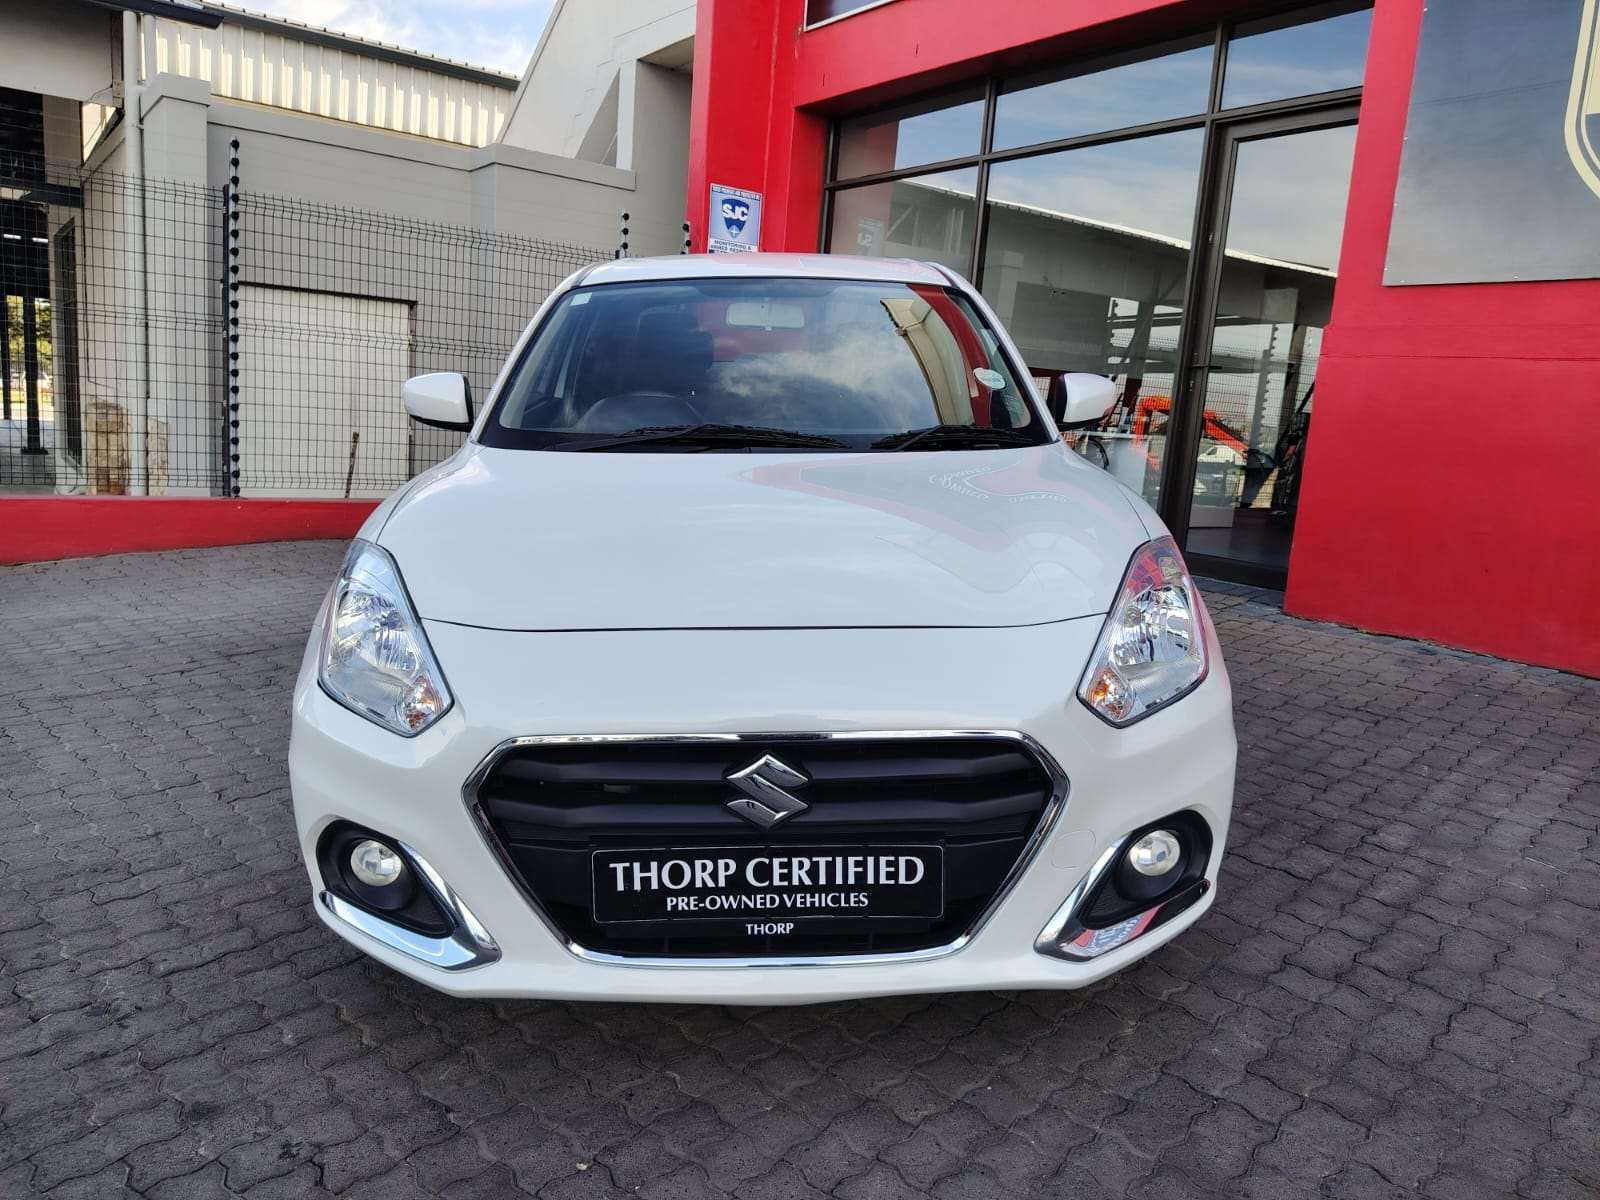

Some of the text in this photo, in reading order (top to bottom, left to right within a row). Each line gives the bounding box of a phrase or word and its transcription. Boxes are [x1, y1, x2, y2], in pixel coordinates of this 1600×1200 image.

[722, 203, 748, 221] SJC
[609, 856, 925, 892] THORP CERTIFIED
[666, 892, 869, 911] PRE-OWNED VEHICLES
[745, 922, 794, 935] THORP
